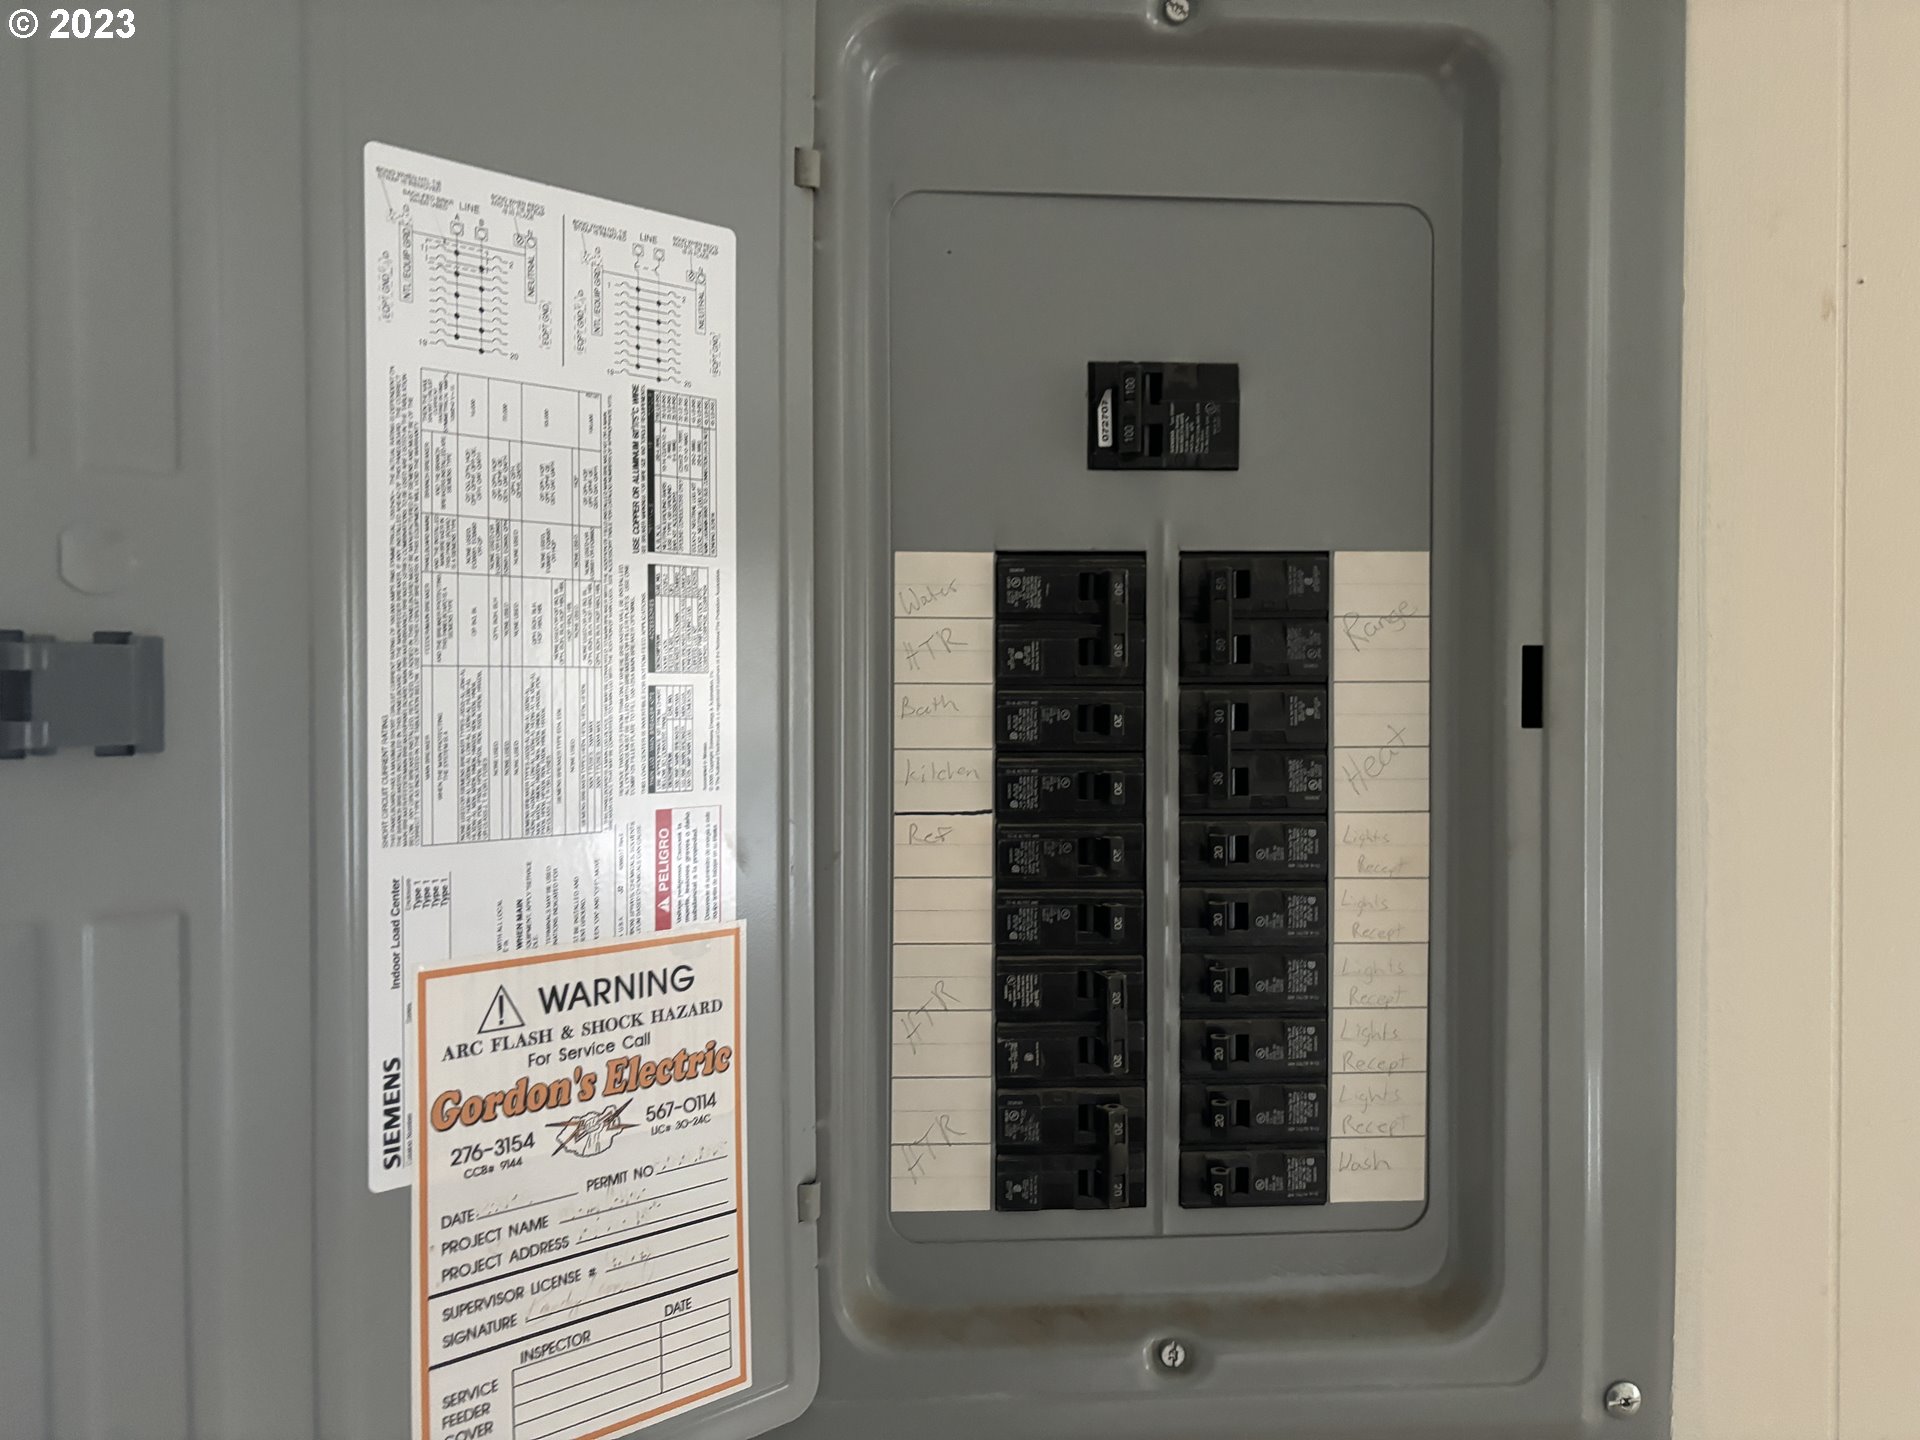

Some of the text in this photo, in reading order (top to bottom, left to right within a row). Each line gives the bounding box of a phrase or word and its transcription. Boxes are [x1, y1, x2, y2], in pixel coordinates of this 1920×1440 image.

[458, 202, 481, 215] LINE
[639, 231, 659, 244] LINE
[1125, 376, 1136, 396] 100
[1124, 424, 1135, 443] 100
[632, 487, 639, 499] OR
[899, 579, 957, 615] Water
[1114, 582, 1124, 596] 30
[1342, 600, 1418, 652] Range
[903, 627, 968, 671] HTR
[1113, 643, 1124, 658] 30
[901, 694, 960, 719] Bath
[1214, 709, 1225, 724] 30
[1114, 714, 1124, 728] 20
[1342, 724, 1406, 796] Heat
[1113, 782, 1123, 796] 20
[1213, 771, 1224, 785] 30
[1343, 825, 1390, 849] Lights
[658, 828, 669, 892] PELIGRO
[1113, 849, 1123, 863] 20
[1213, 845, 1224, 859] 20
[413, 888, 422, 910] Type
[422, 887, 431, 908] Type
[431, 886, 440, 907] Type
[440, 885, 449, 906] Type
[1113, 916, 1123, 930] 20
[1213, 912, 1224, 926] 20
[390, 879, 401, 989] Indoor Load Center
[538, 964, 695, 1015] WARNING
[1213, 979, 1223, 993] 20
[1112, 991, 1122, 1006] 20
[900, 980, 961, 1056] HTR
[441, 999, 723, 1062] ARC FLASH & SHOCK HAZARD
[1340, 1018, 1399, 1047] Lights
[527, 1032, 651, 1068] For Service Call
[1113, 1054, 1123, 1068] 20
[1214, 1046, 1224, 1061] 20
[1342, 1051, 1411, 1076] Recept
[430, 1040, 733, 1132] Gordon's Electric
[383, 1057, 401, 1170] SIEMENS
[645, 1092, 717, 1123] 567-0114
[1114, 1122, 1124, 1136] 20
[1215, 1114, 1225, 1127] 20
[1342, 1115, 1409, 1137] Recept
[450, 1132, 536, 1167] 276-3154
[900, 1114, 968, 1185] HTR
[586, 1164, 655, 1192] PERMIT NO
[1114, 1183, 1124, 1197] 20
[1213, 1182, 1224, 1197] 20
[441, 1208, 475, 1229] DATE
[441, 1215, 549, 1256] PROJECT NAME
[441, 1235, 570, 1282] PROJECT ADDRESS
[442, 1286, 525, 1323] SUPERVISOR
[530, 1269, 582, 1296] LICENSE
[588, 1267, 597, 1278] #
[442, 1313, 518, 1349] SIGNATURE
[520, 1329, 592, 1364] INSPECTOR
[664, 1296, 693, 1318] DATE
[442, 1378, 499, 1409] SERVICE
[442, 1402, 491, 1430] FEEDER
